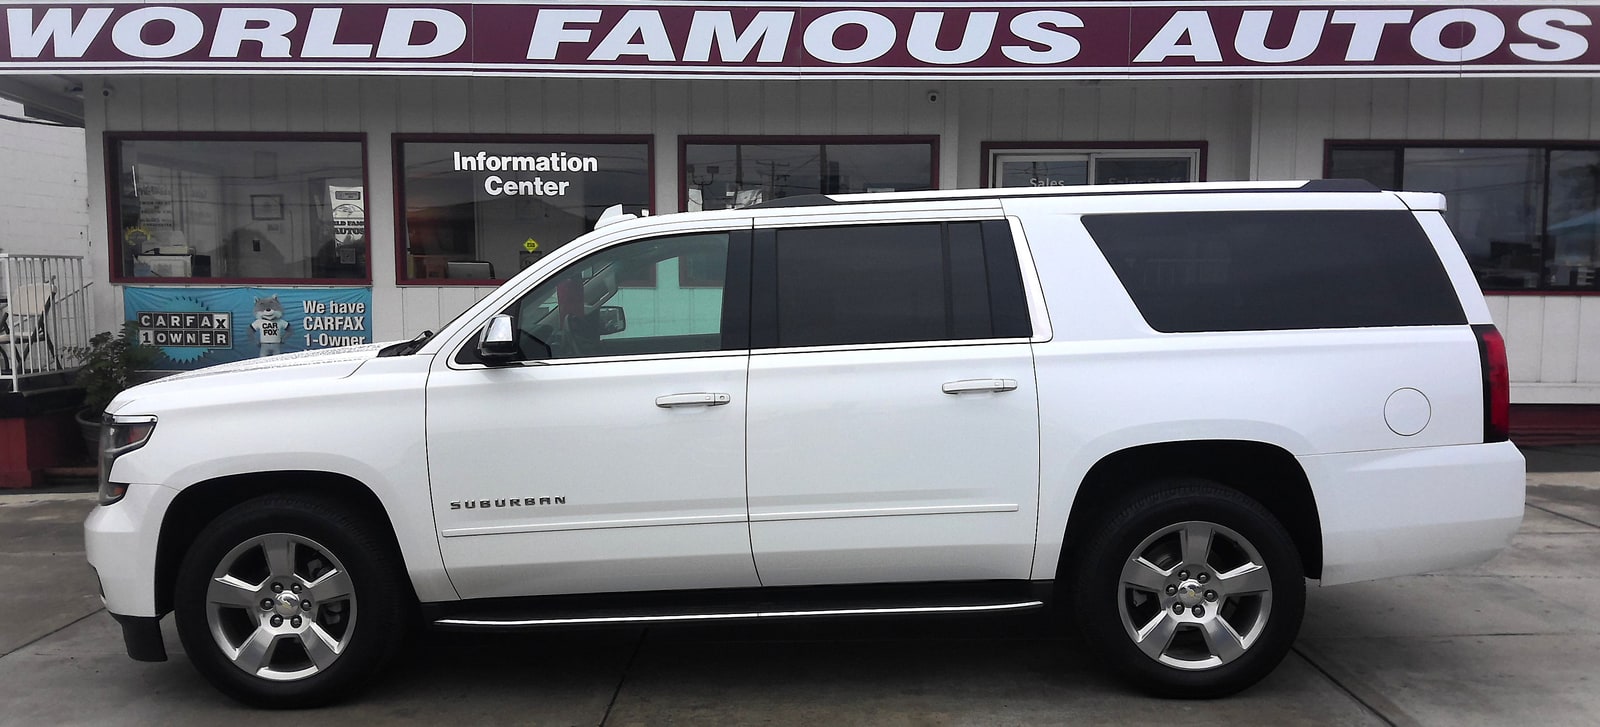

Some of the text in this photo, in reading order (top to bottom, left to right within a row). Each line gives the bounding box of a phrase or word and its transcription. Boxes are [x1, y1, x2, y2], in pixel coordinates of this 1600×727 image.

[6, 6, 1593, 64] WORLD FAMOUS AUTOS
[453, 151, 598, 172] Information
[484, 175, 570, 196] Center
[303, 300, 365, 314] We have
[141, 315, 227, 329] CARFAX
[303, 316, 365, 331] CARFAX
[303, 333, 366, 347] 1-Owner
[450, 496, 566, 510] SUBURBAN
